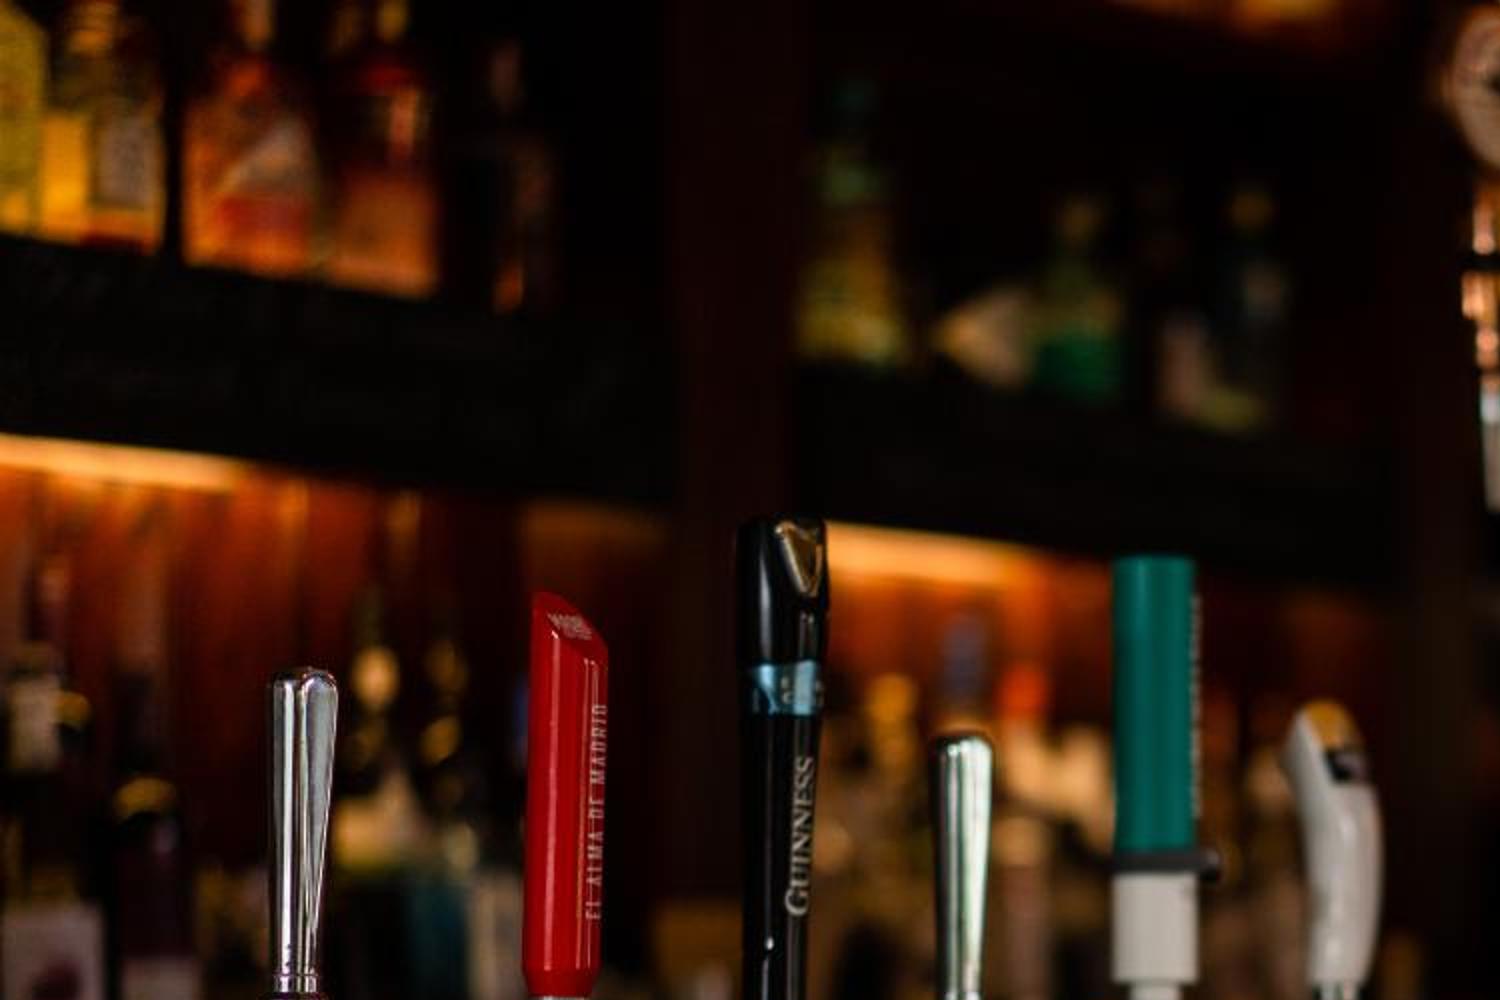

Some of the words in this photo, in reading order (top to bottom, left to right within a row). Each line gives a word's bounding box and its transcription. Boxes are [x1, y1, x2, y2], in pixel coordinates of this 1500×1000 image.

[590, 704, 608, 785] MADRID
[586, 831, 605, 886] ALMA
[785, 756, 814, 915] GUINNESS
